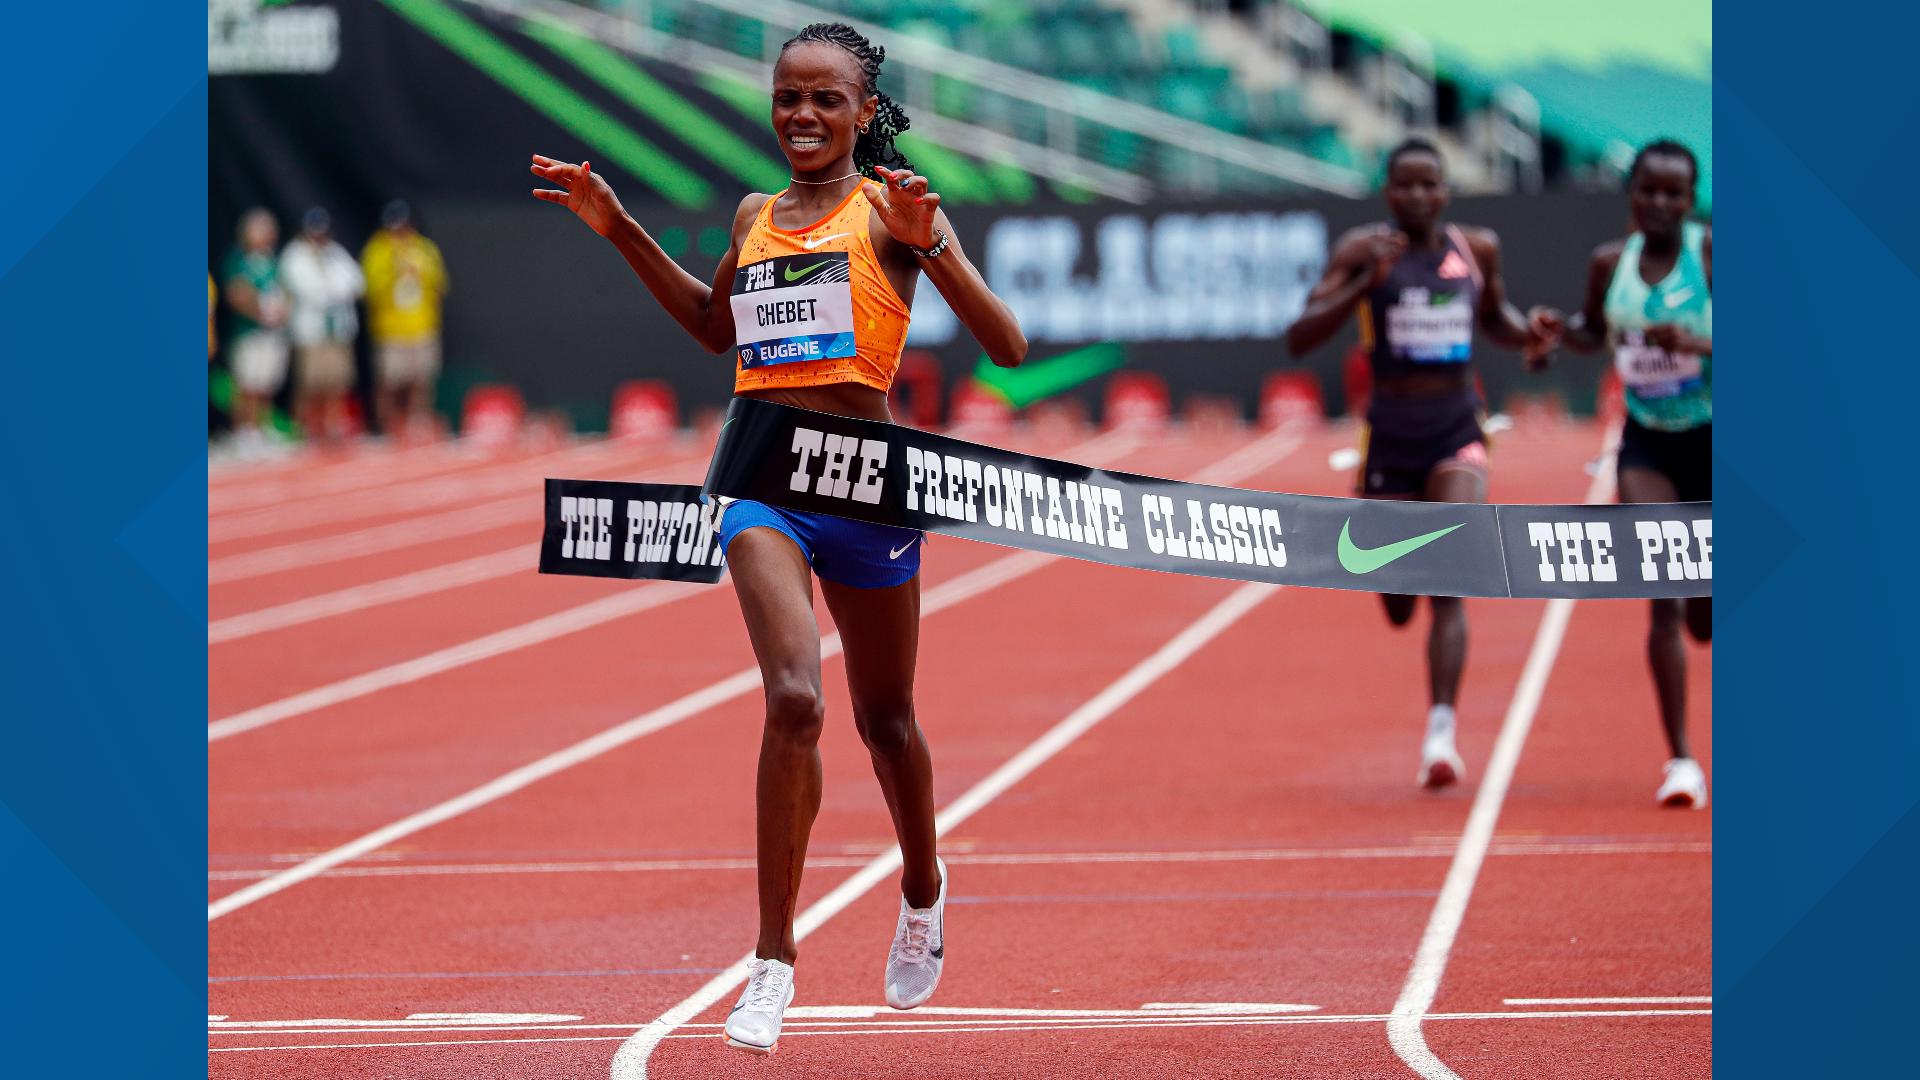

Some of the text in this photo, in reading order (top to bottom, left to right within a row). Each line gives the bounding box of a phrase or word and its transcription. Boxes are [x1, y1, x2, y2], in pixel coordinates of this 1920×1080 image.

[745, 261, 775, 291] PRE
[757, 299, 817, 327] CHEBET
[760, 341, 819, 360] EUGENE
[790, 427, 1287, 567] THE PREFONTAINE CLASSIC
[561, 497, 613, 560] THE
[1528, 520, 1712, 581] THE PRE
